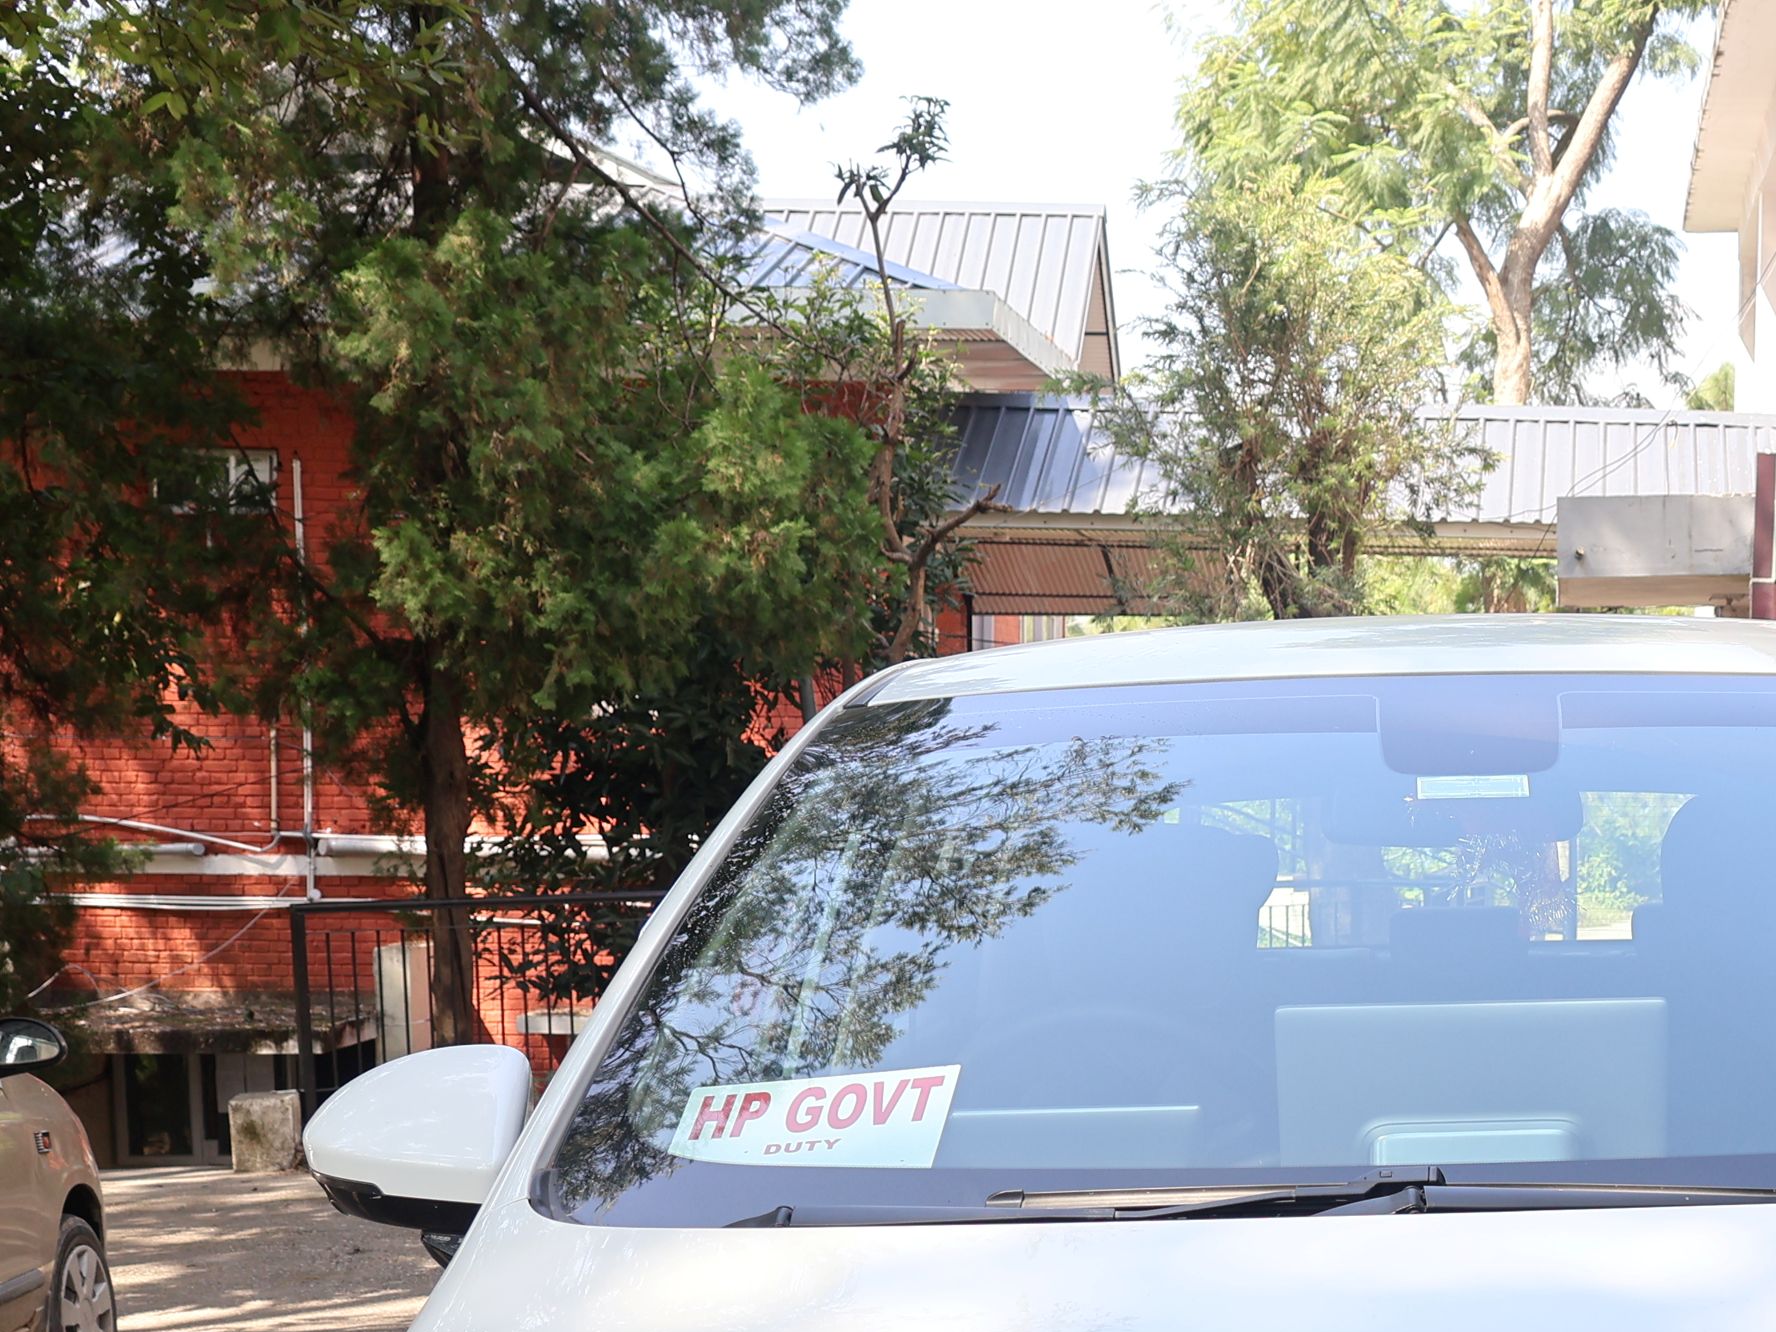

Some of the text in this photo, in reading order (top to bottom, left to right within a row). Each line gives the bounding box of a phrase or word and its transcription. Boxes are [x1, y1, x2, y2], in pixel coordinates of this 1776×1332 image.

[688, 1075, 946, 1141] HP GOVT
[763, 1137, 842, 1156] DUTY
